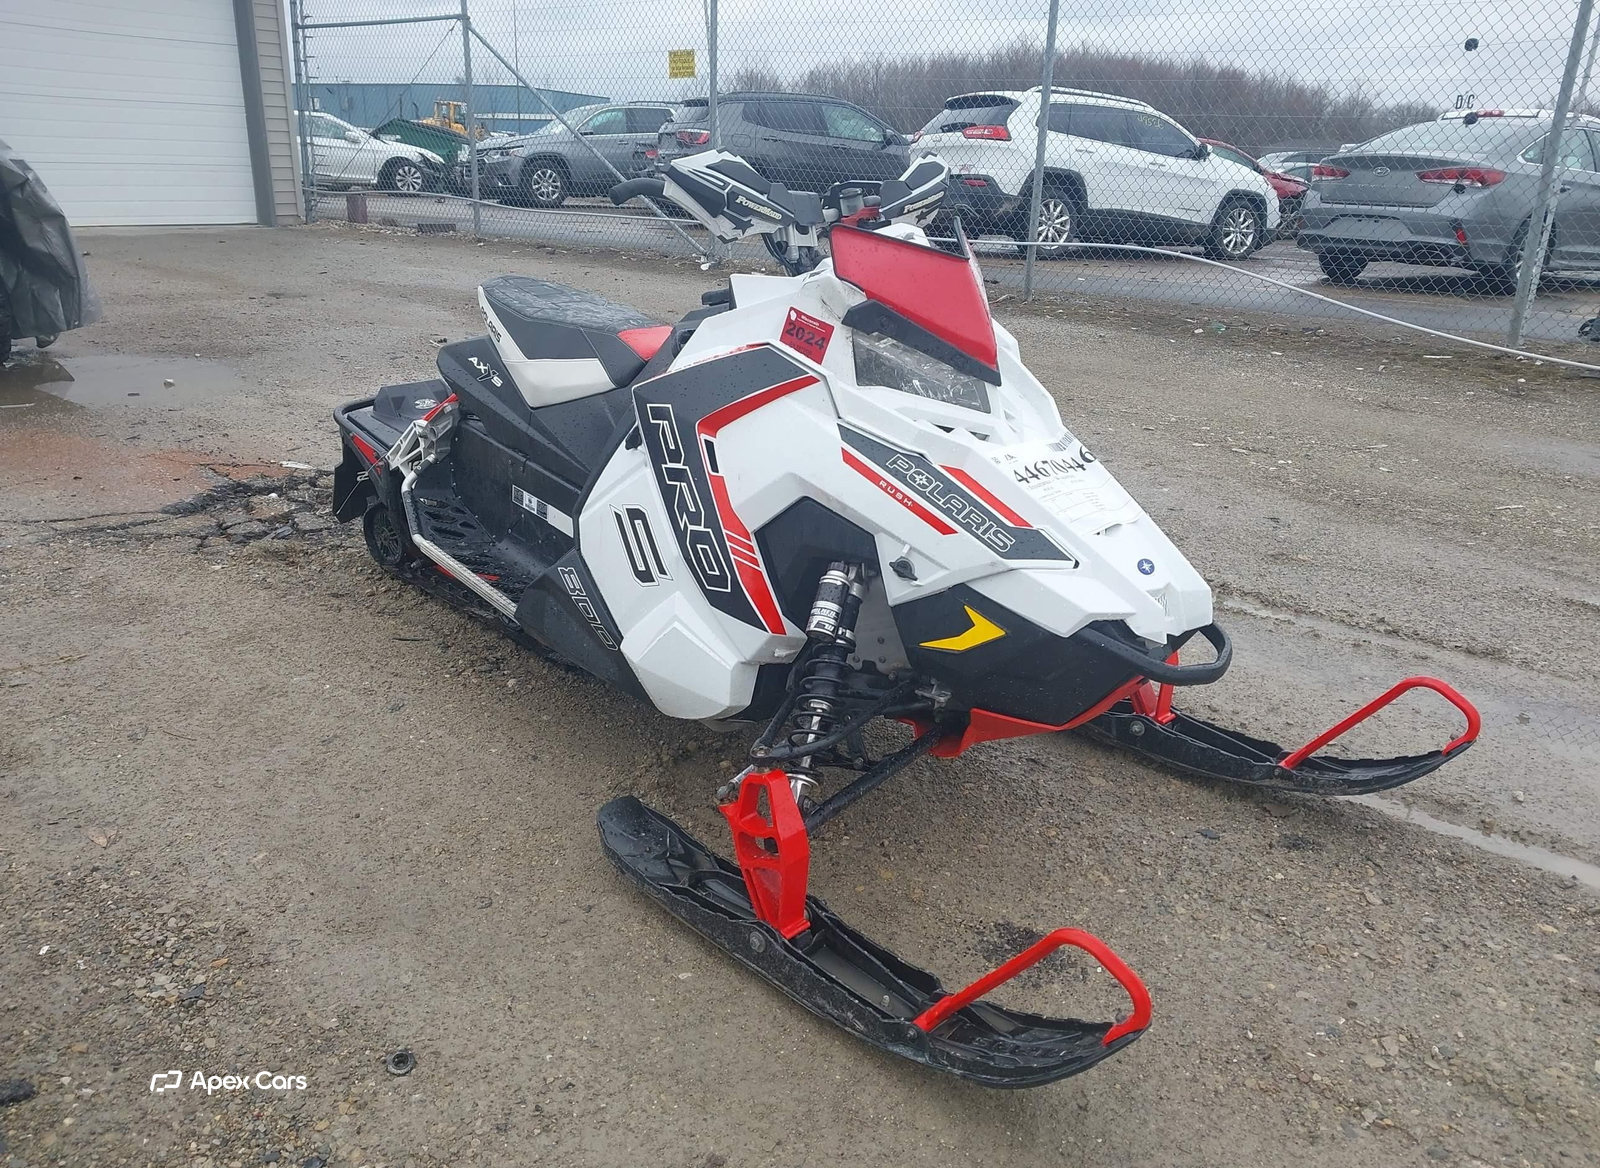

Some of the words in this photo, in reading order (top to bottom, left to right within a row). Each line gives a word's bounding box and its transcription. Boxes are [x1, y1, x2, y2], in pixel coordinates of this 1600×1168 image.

[785, 322, 826, 350] 2024
[879, 480, 912, 507] RUSH
[1013, 446, 1097, 484] 44670446
[646, 403, 731, 592] PRO
[886, 454, 1015, 553] POLARIS
[557, 567, 619, 650] 800
